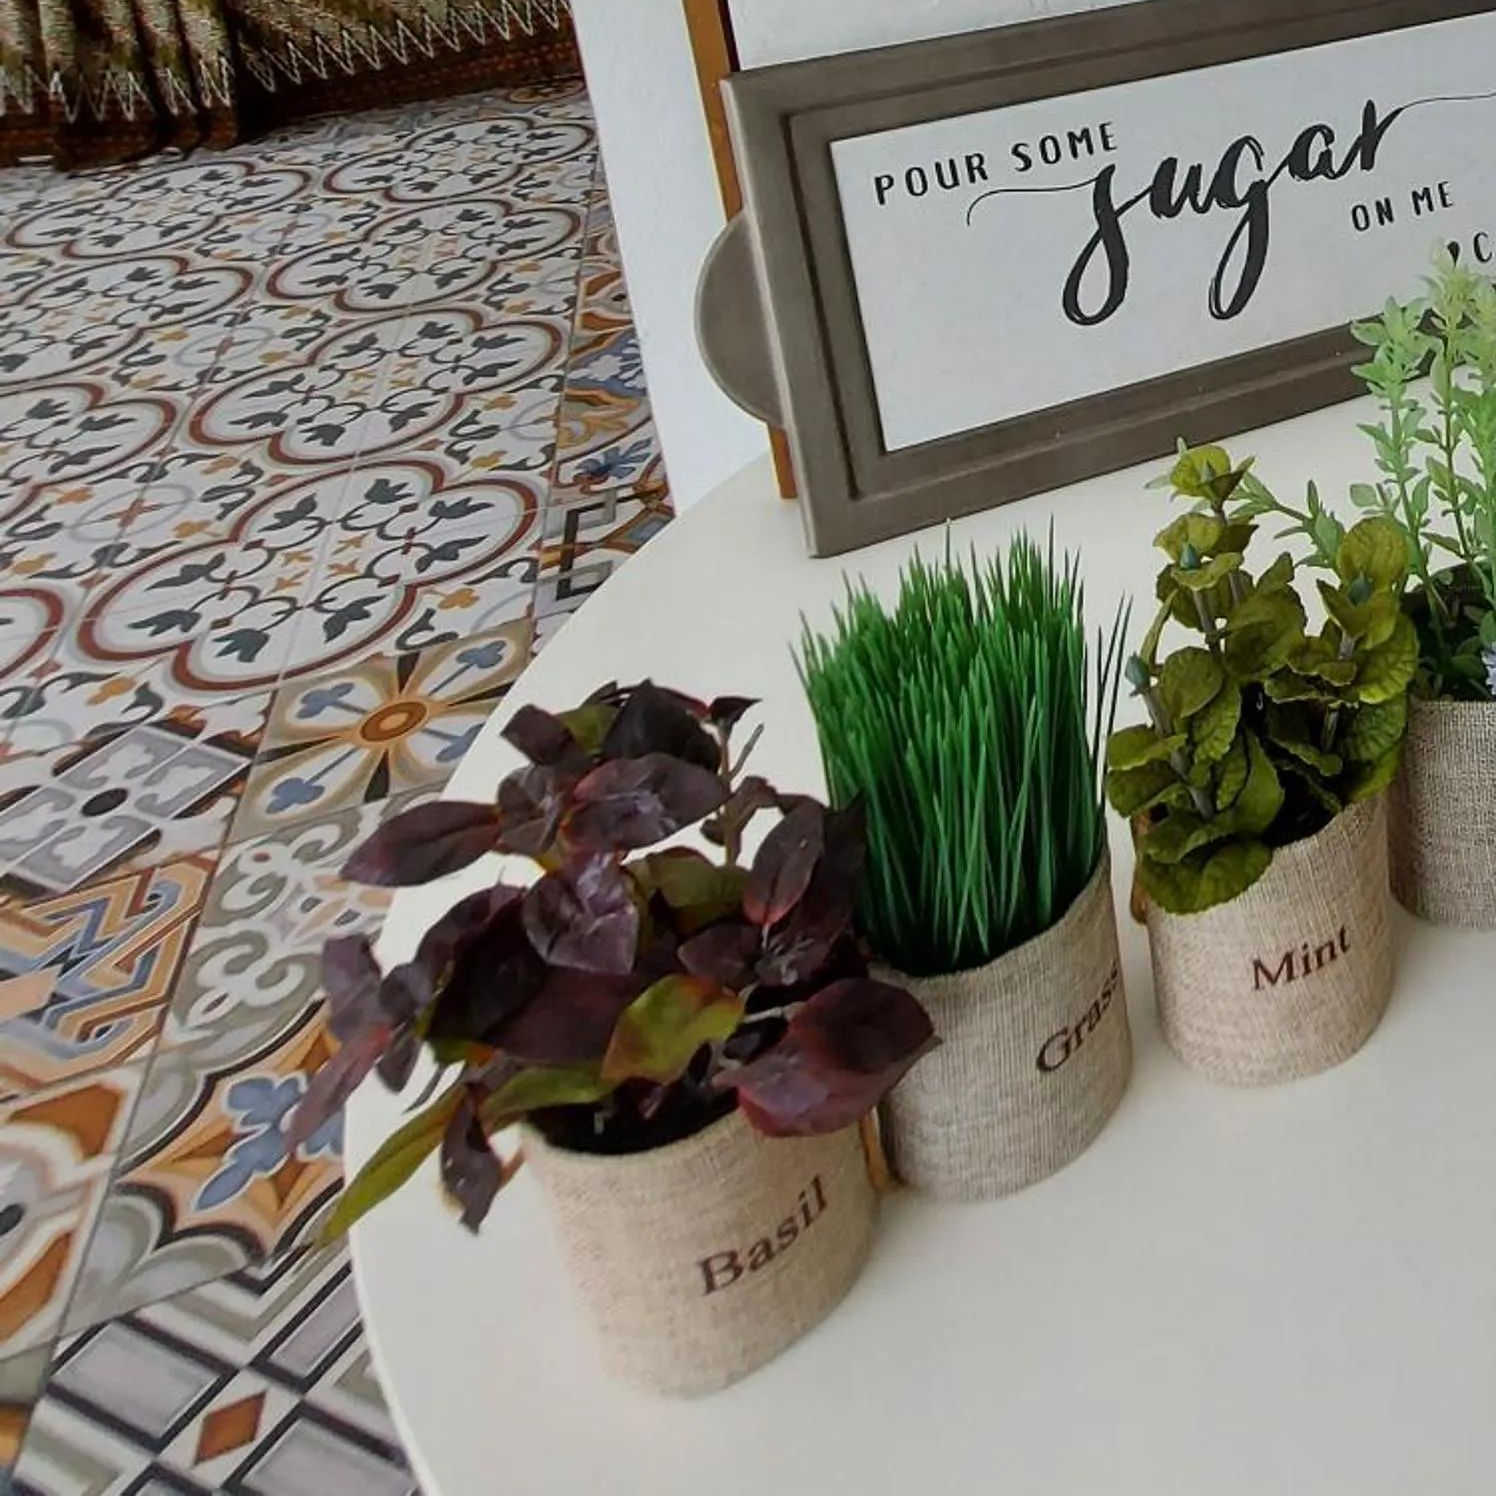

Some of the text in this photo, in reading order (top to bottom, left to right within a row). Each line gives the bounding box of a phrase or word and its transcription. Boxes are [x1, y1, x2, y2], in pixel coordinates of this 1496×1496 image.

[874, 121, 1118, 206] POUR SOME
[1350, 180, 1454, 232] ON ME
[1253, 924, 1352, 991] Mint
[697, 1173, 828, 1297] Basil
